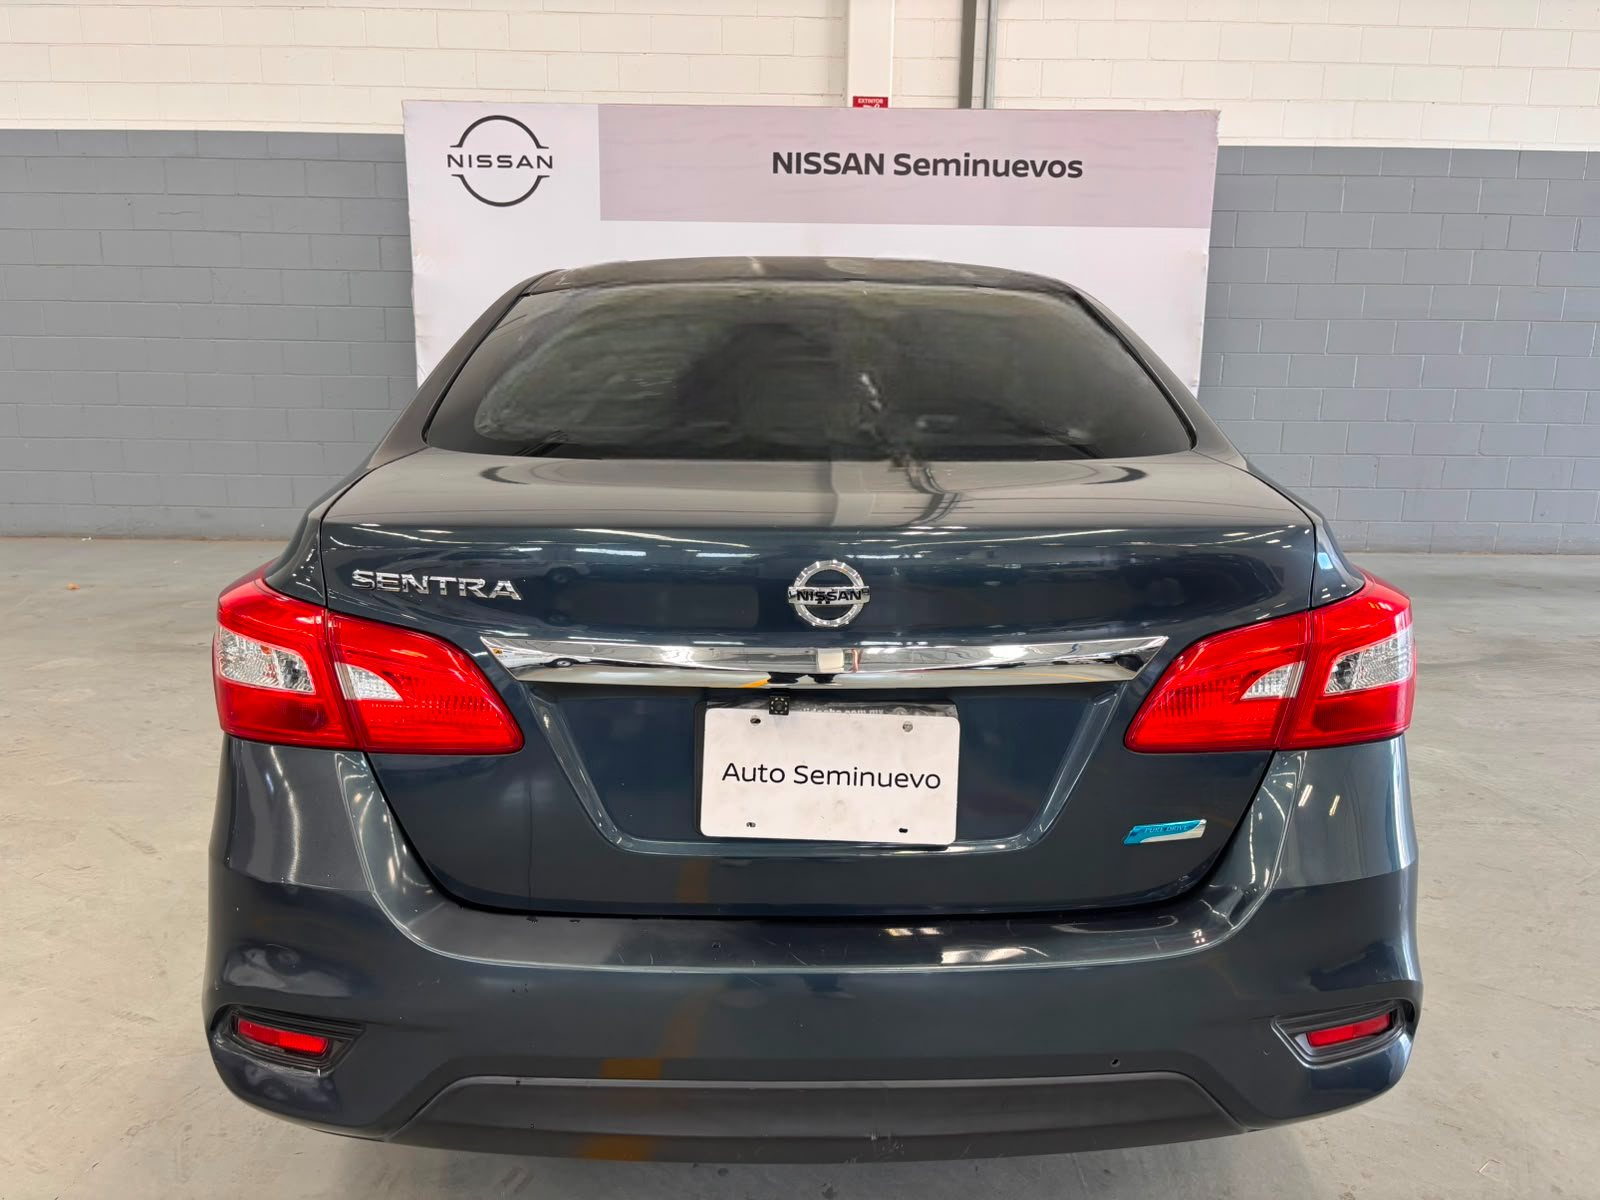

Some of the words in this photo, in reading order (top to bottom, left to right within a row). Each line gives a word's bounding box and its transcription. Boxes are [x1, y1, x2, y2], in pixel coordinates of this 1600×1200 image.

[447, 154, 553, 169] NISSAN
[772, 151, 885, 175] NISSAN
[893, 152, 1083, 179] Seminuevos
[351, 569, 522, 601] SENTRA
[796, 589, 862, 601] NISSAN
[722, 762, 785, 783] Auto
[793, 764, 941, 789] Seminuevo
